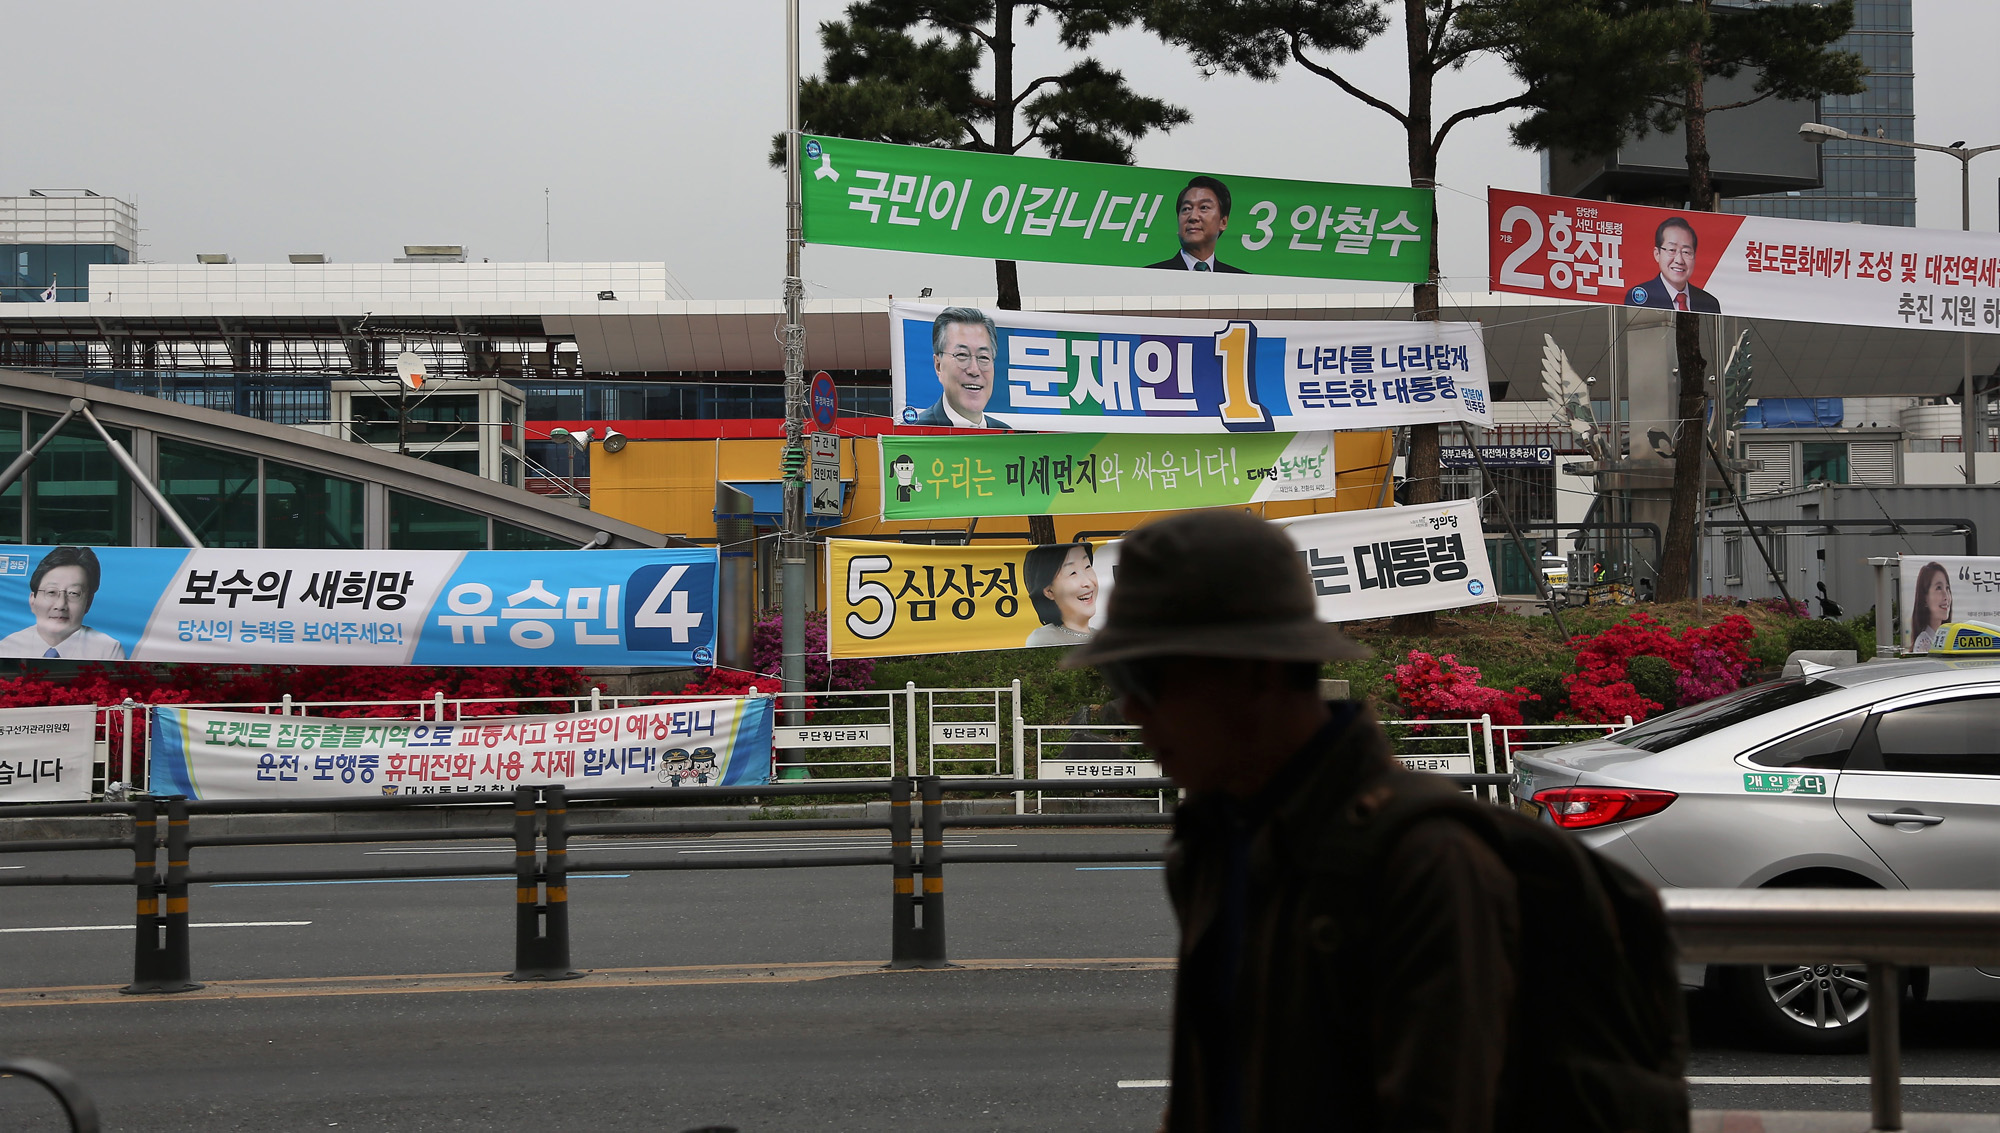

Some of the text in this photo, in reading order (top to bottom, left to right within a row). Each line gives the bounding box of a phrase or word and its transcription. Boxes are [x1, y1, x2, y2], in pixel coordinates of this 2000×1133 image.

[847, 168, 1164, 244] 국민이 이깁니다!
[1576, 207, 1598, 218] 당당한
[1241, 200, 1422, 257] 3 안철수
[1500, 234, 1513, 244] 기호
[1575, 219, 1623, 235] 서민 대통령
[1499, 205, 1625, 295] 2 홍준표
[1745, 240, 2000, 288] 철도문화메카 조성 및 대전역세
[1898, 292, 1933, 324] 추진
[1941, 295, 1976, 326] 지원
[1297, 344, 1469, 375] 나라를 나라답게
[1008, 320, 1275, 432] 문재인 1
[1298, 376, 1458, 409] 든든한 대통령
[1461, 387, 1484, 401] 더불어
[1464, 399, 1486, 414] 민주당
[1441, 448, 1548, 459] 경부고속철 대전역사 증축공사 2
[813, 468, 839, 482] 견인지역
[926, 447, 1240, 500] 우리는 미세먼지와 싸웁니다!
[1247, 455, 1325, 481] 대전 녹색당
[1429, 515, 1458, 530] 정의당
[1295, 533, 1469, 596] 는 대통령
[178, 568, 414, 612] 보수의 새희망
[846, 555, 1019, 640] 5 심상정
[438, 565, 703, 649] 유승민 4
[177, 619, 403, 647] 당신의 능력을 보여주세요!
[1960, 636, 1992, 648] CARD
[205, 709, 716, 751] 포켓몬 집중출몰지역으로 교통사고 위험이 예상되니
[798, 730, 870, 742] 무단횡단금지
[942, 727, 989, 739] 횡단금지
[0, 758, 63, 785] 습니다
[385, 752, 476, 782] 휴대전화
[480, 750, 524, 782] 사용
[530, 749, 575, 778] 자제
[583, 746, 656, 777] 합시다!
[1065, 765, 1136, 777] 무단횡단금지
[1397, 759, 1450, 771] 횡단금지
[1804, 777, 1823, 793] 다
